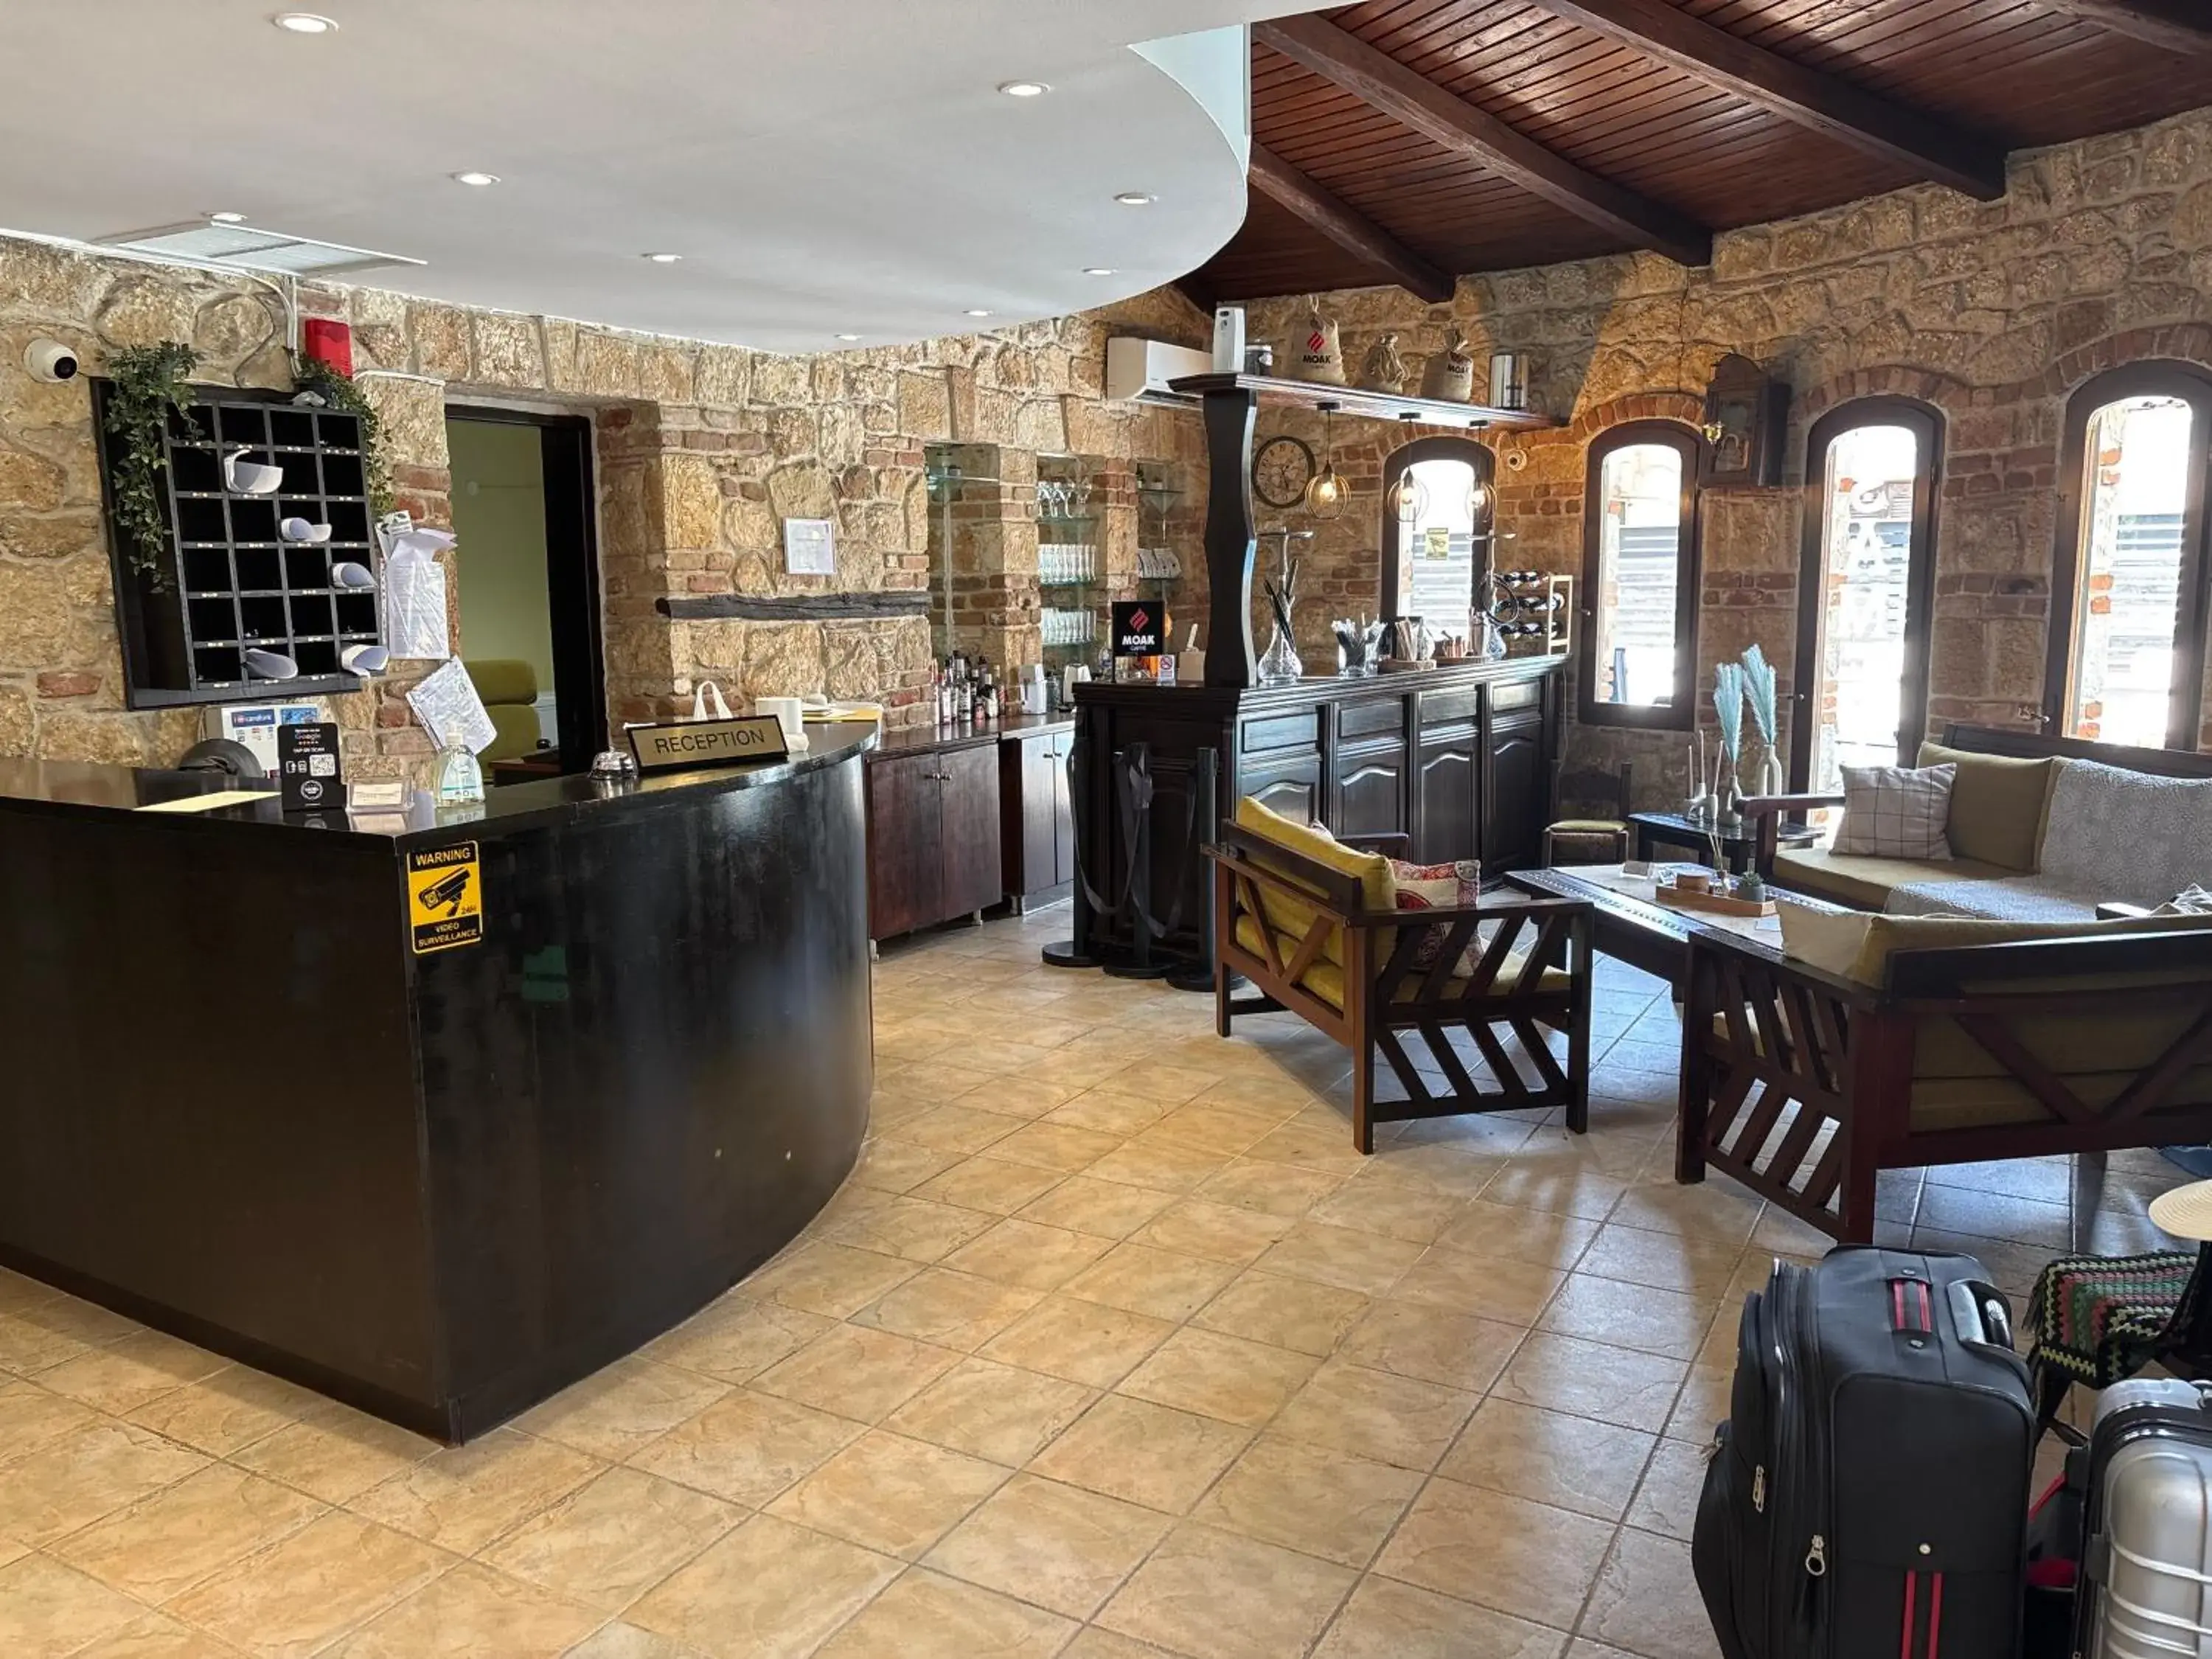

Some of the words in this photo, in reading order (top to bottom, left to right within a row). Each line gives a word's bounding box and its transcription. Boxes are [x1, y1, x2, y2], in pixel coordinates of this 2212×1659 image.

[1303, 355, 1332, 364] MOAK
[1121, 635, 1155, 645] MOAK
[654, 728, 765, 754] RECEPTION
[415, 847, 471, 866] WARNING
[435, 922, 459, 933] VIDEO
